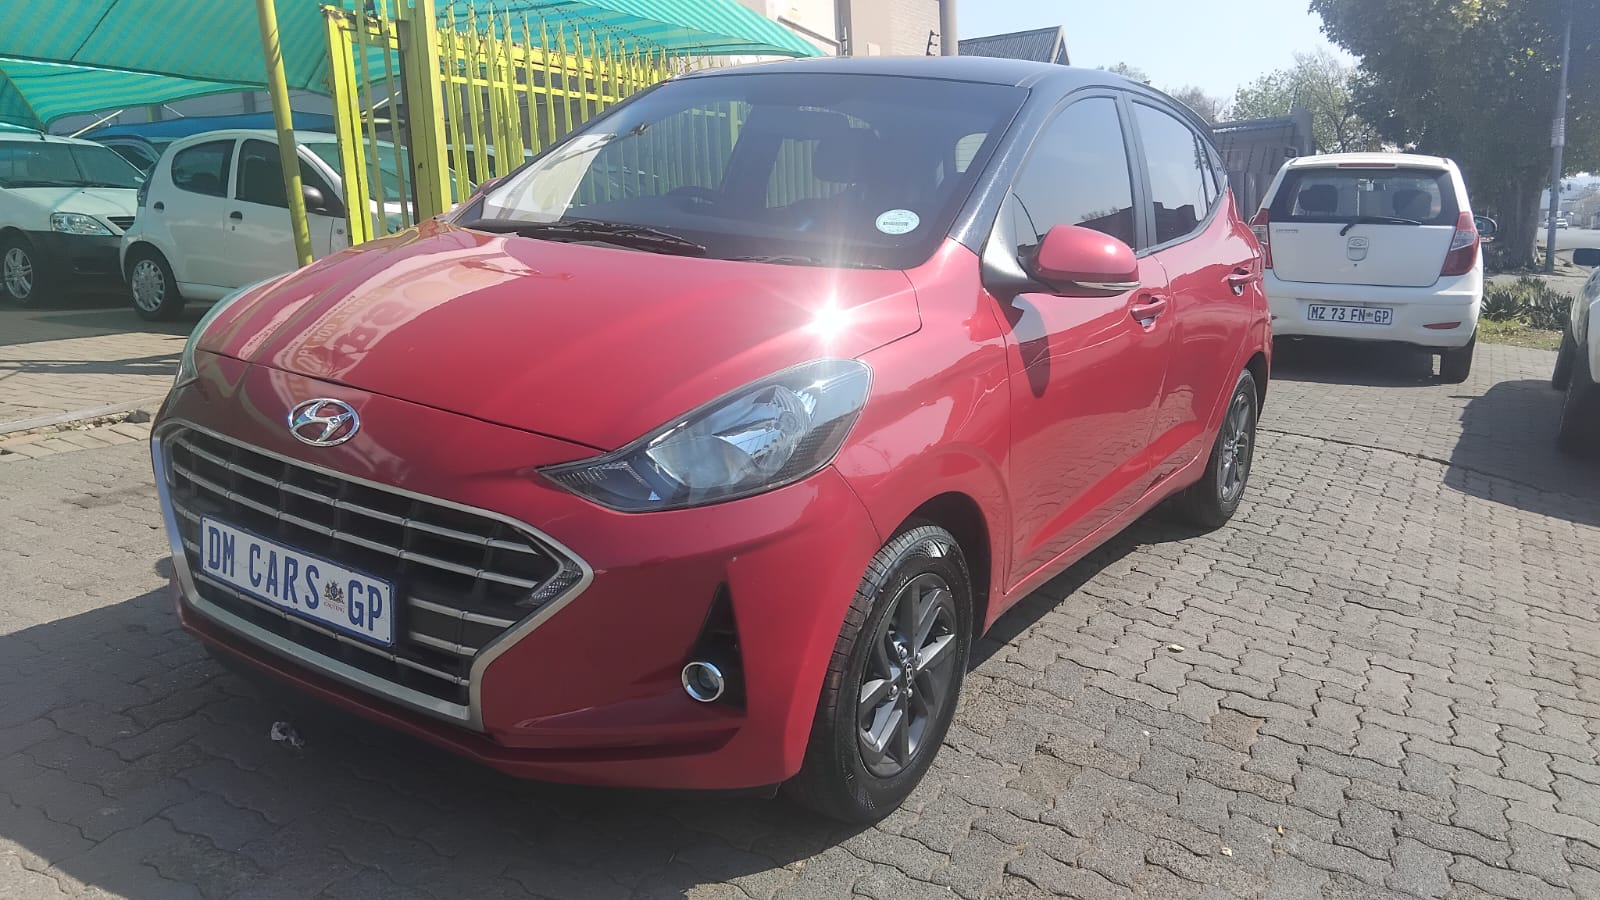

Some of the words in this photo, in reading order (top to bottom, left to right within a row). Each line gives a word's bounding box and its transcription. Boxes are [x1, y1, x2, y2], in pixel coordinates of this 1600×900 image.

[1311, 306, 1326, 319] MZ
[1331, 307, 1346, 320] 73
[1350, 308, 1366, 321] FN
[1374, 310, 1389, 323] GP
[208, 526, 235, 578] DM
[249, 543, 320, 610] CARS
[347, 579, 383, 631] GP
